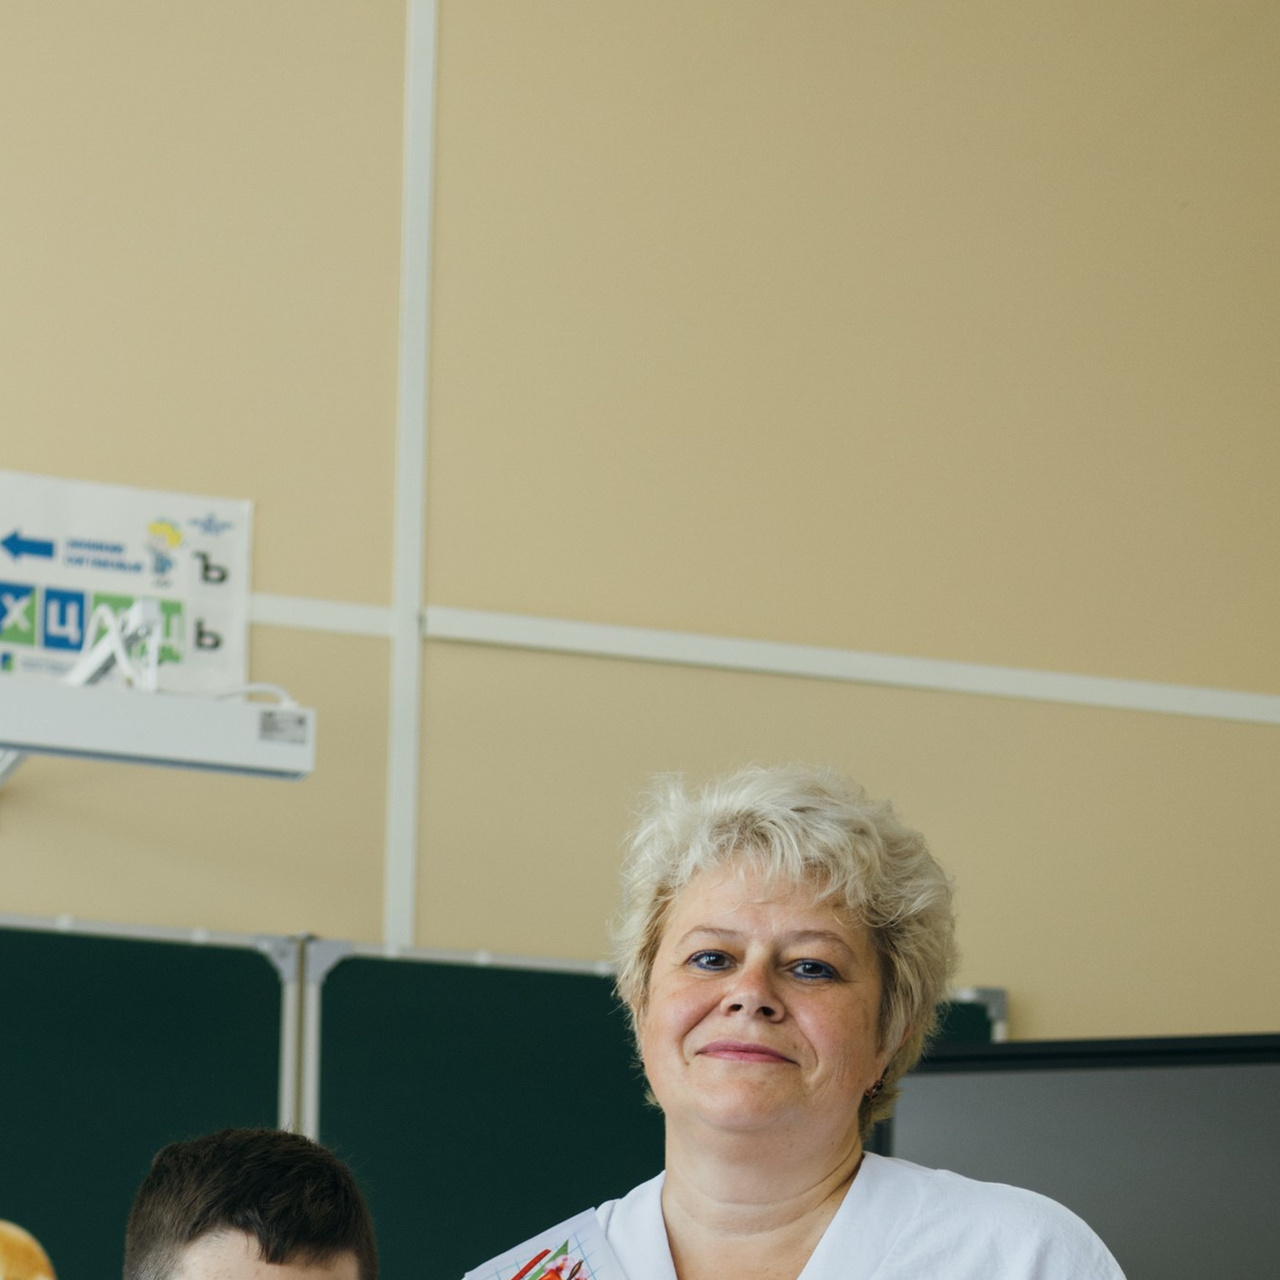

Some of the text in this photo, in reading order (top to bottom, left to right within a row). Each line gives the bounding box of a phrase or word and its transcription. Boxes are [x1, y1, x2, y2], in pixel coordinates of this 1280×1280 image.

[193, 551, 229, 584] Ъ
[0, 593, 31, 632] Х
[47, 600, 80, 645] Ц
[195, 618, 222, 650] Ь
